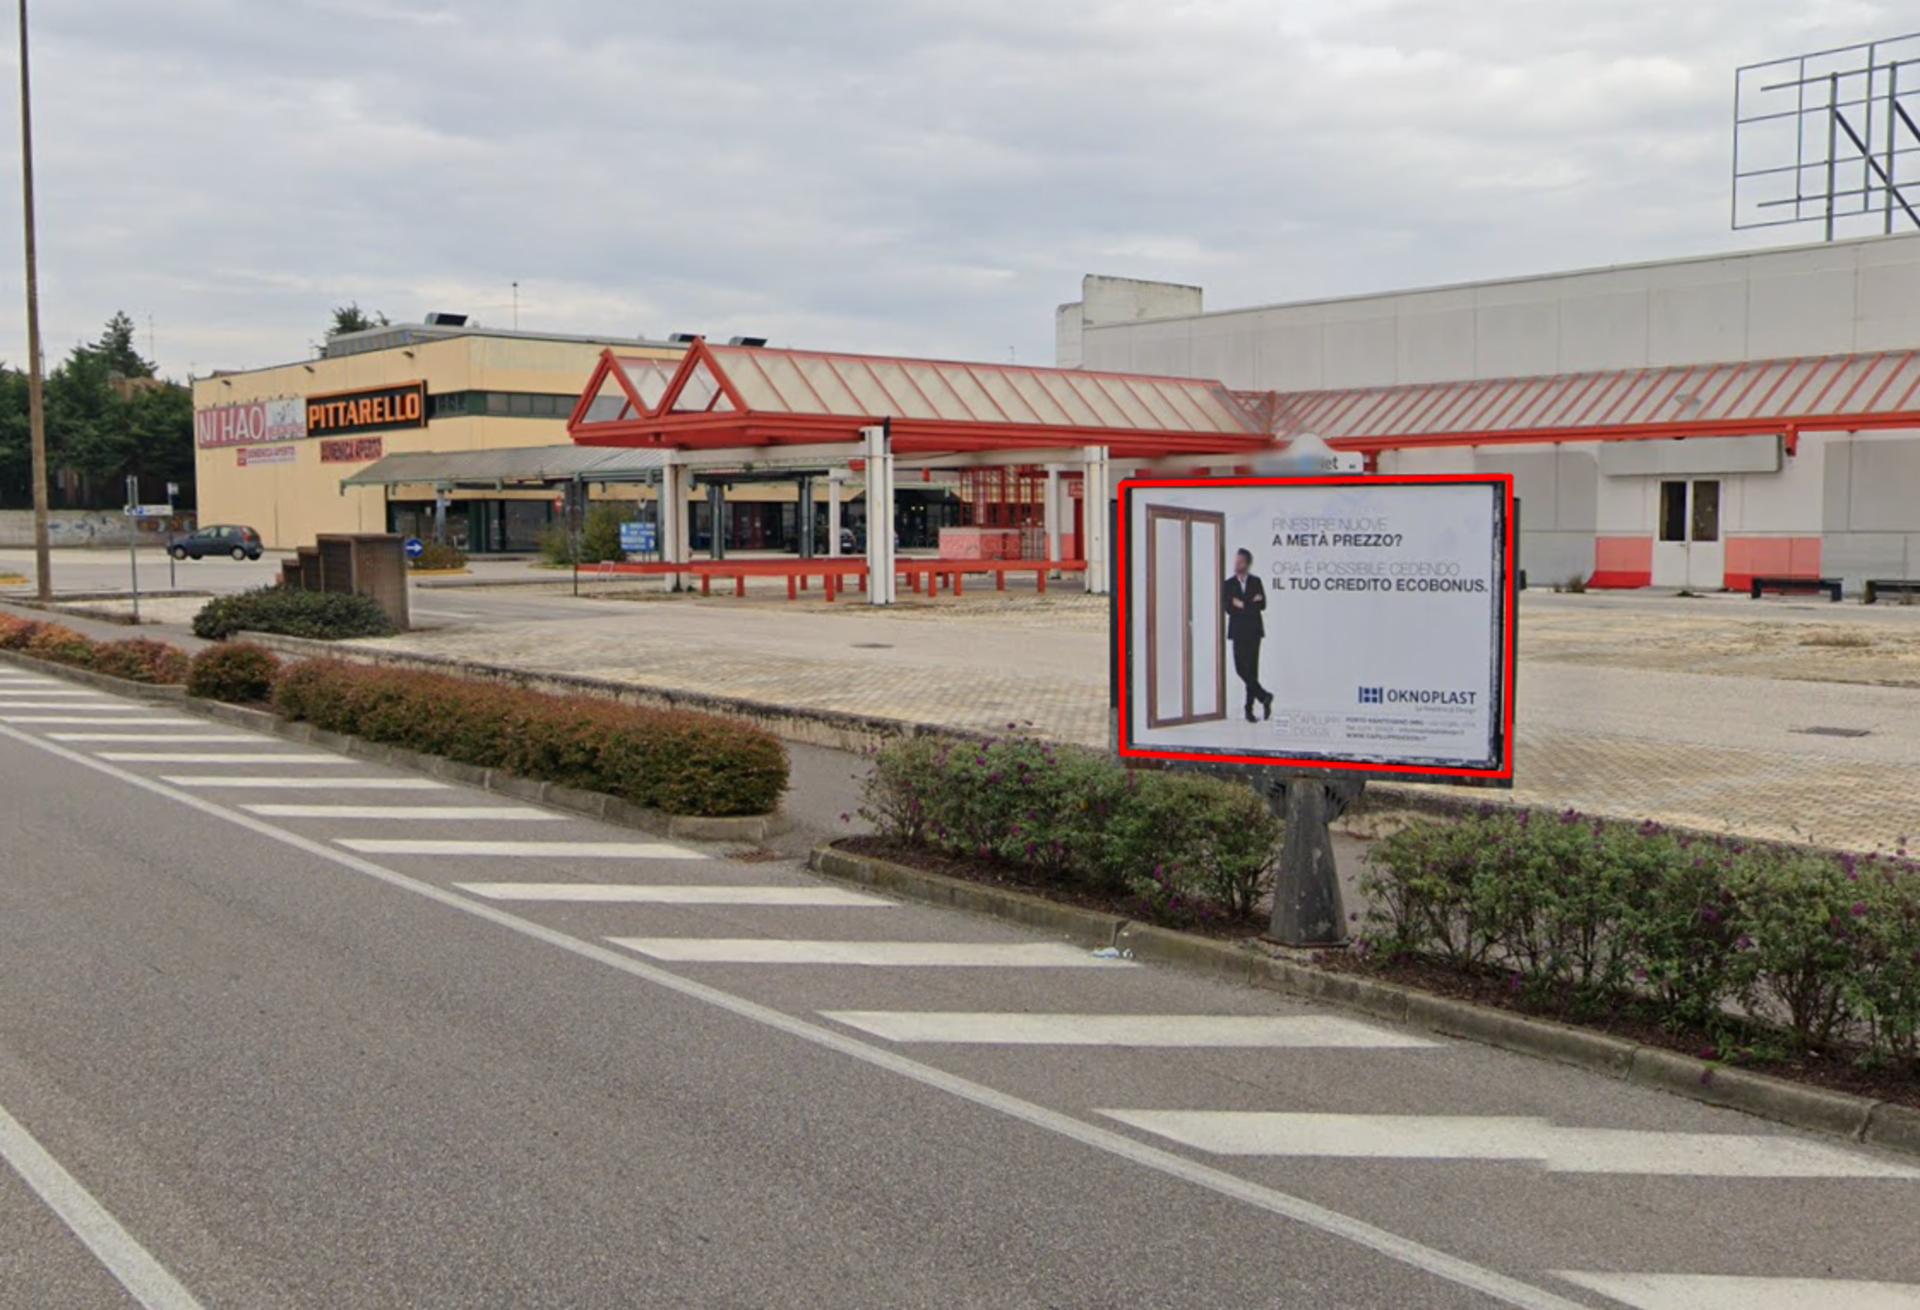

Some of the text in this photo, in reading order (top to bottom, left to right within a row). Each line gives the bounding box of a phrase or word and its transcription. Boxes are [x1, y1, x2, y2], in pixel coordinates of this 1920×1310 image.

[308, 393, 420, 429] PITTARELLO
[200, 410, 218, 443] NI
[221, 405, 265, 441] HAO
[1272, 517, 1388, 531] FINESTRE NUOVE
[1272, 531, 1403, 547] A METÀ PREZZO?
[1272, 562, 1301, 575] ORA
[1316, 562, 1384, 576] POSSIBILE
[1389, 562, 1461, 577] CEDENDO
[1272, 578, 1489, 592] IL TUO CREDITO ECOBONUS.
[1386, 688, 1477, 705] OKNOPLAST
